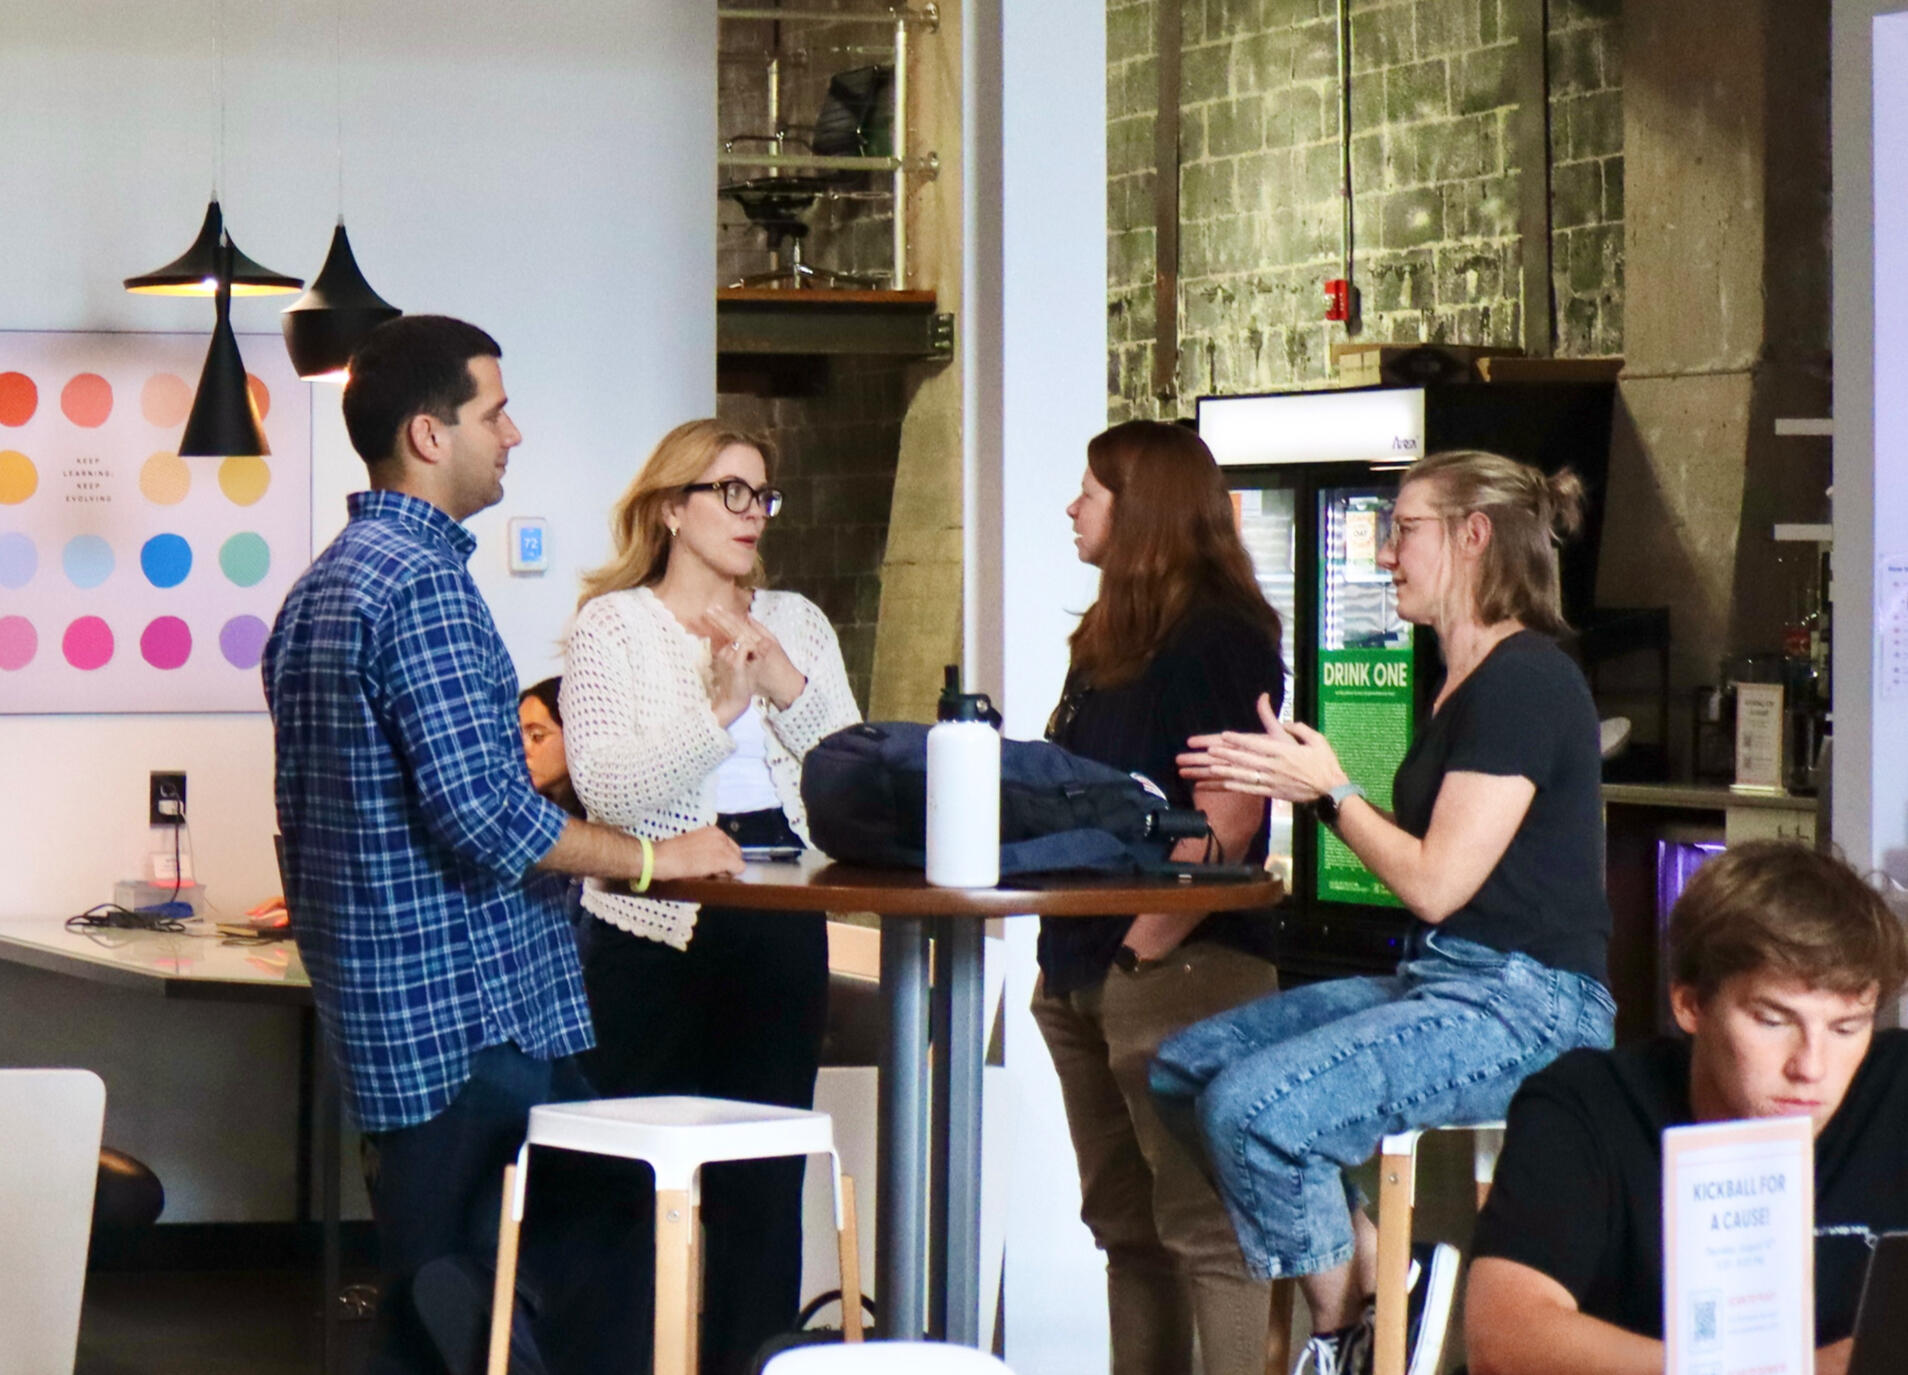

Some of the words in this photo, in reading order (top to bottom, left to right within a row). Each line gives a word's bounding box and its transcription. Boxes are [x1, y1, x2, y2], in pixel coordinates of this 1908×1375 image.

[76, 457, 100, 465] KEEP
[76, 482, 101, 490] KEEP
[65, 495, 112, 503] EVOLVING
[1323, 662, 1371, 687] DRINK
[1373, 662, 1408, 687] ONE
[1692, 1177, 1757, 1202] KICKBALL
[1760, 1173, 1787, 1195] FOR
[1710, 1212, 1720, 1231] A
[1723, 1207, 1770, 1230] CAUSE!
